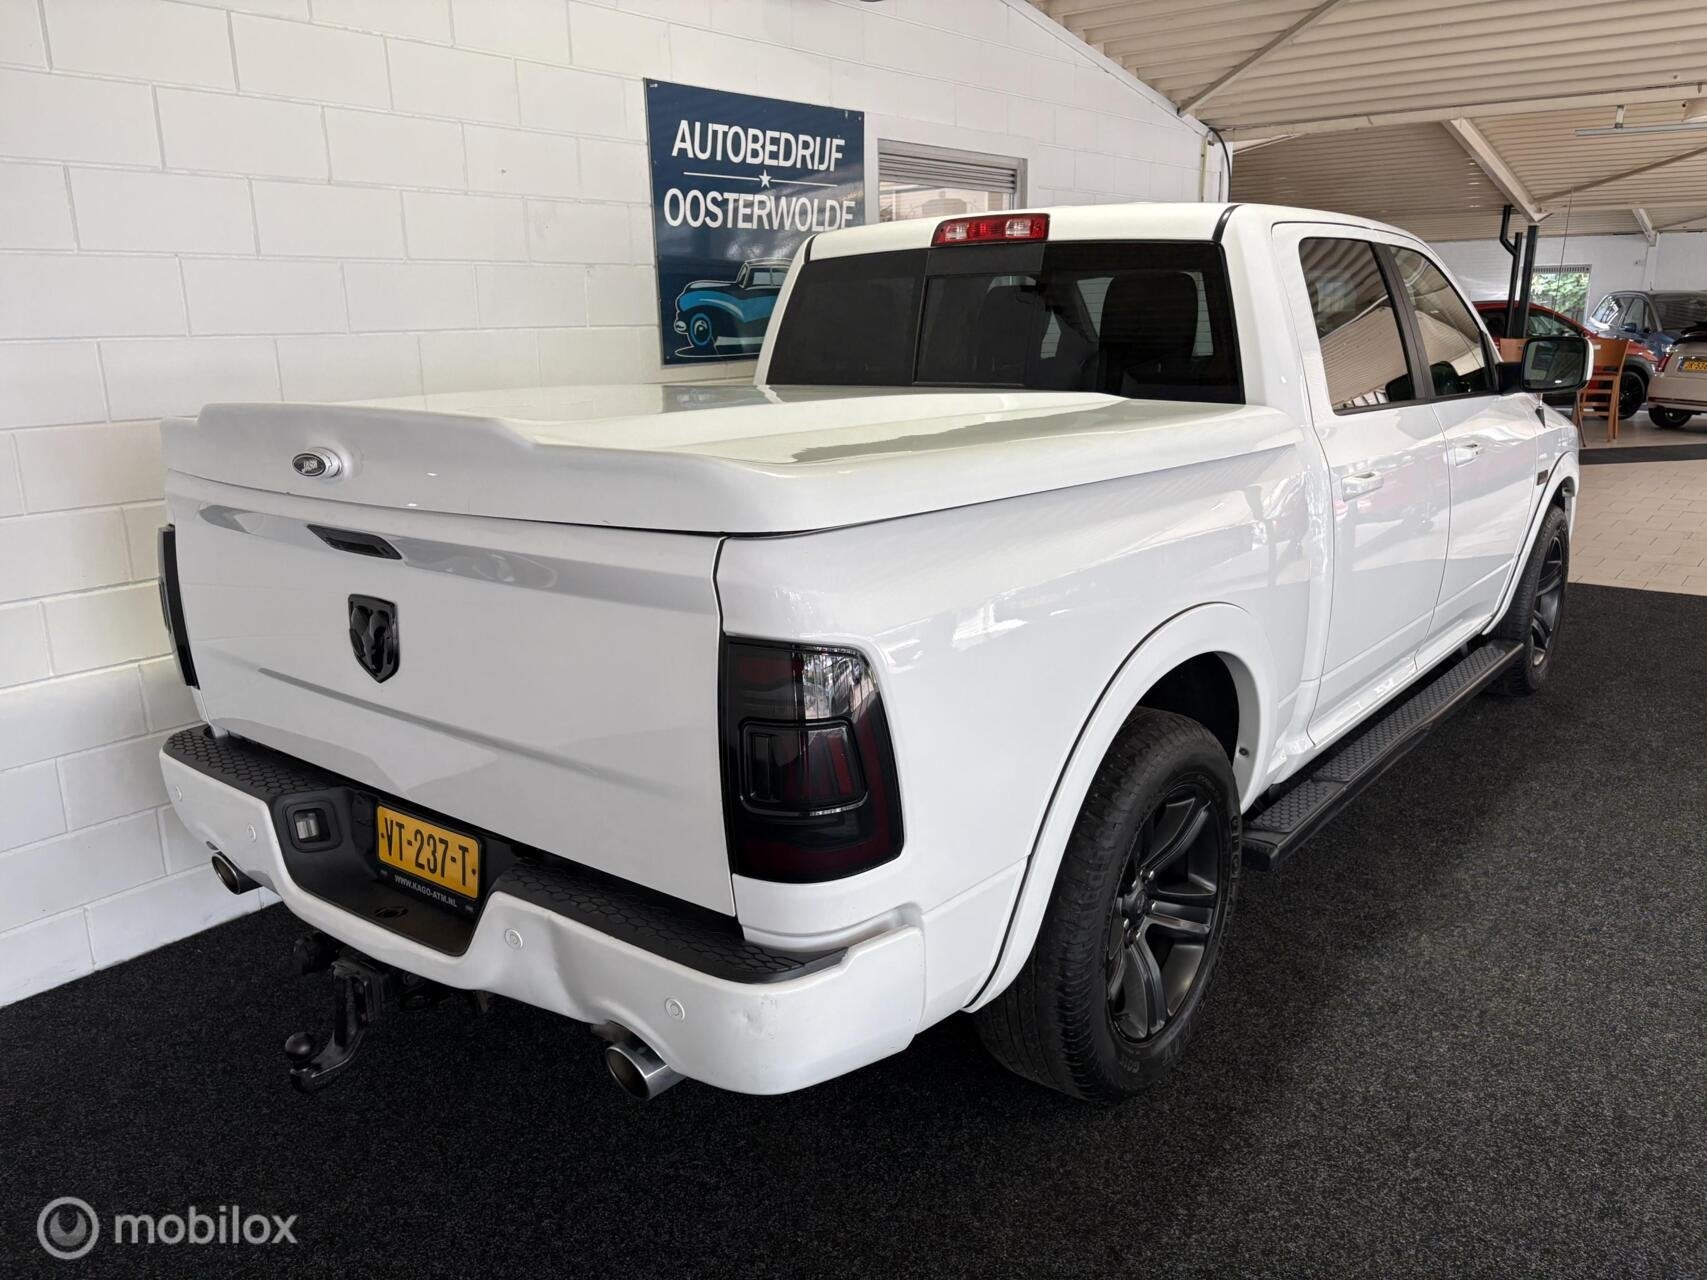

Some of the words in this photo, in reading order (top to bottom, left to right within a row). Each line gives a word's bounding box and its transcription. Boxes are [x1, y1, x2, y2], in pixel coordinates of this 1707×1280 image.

[671, 119, 846, 172] AUTOBEDRIJF
[663, 187, 856, 232] OOSTERWOLDE
[384, 817, 469, 886] VT-237-T
[394, 874, 458, 908] WWW.KAGO-ATM.NL
